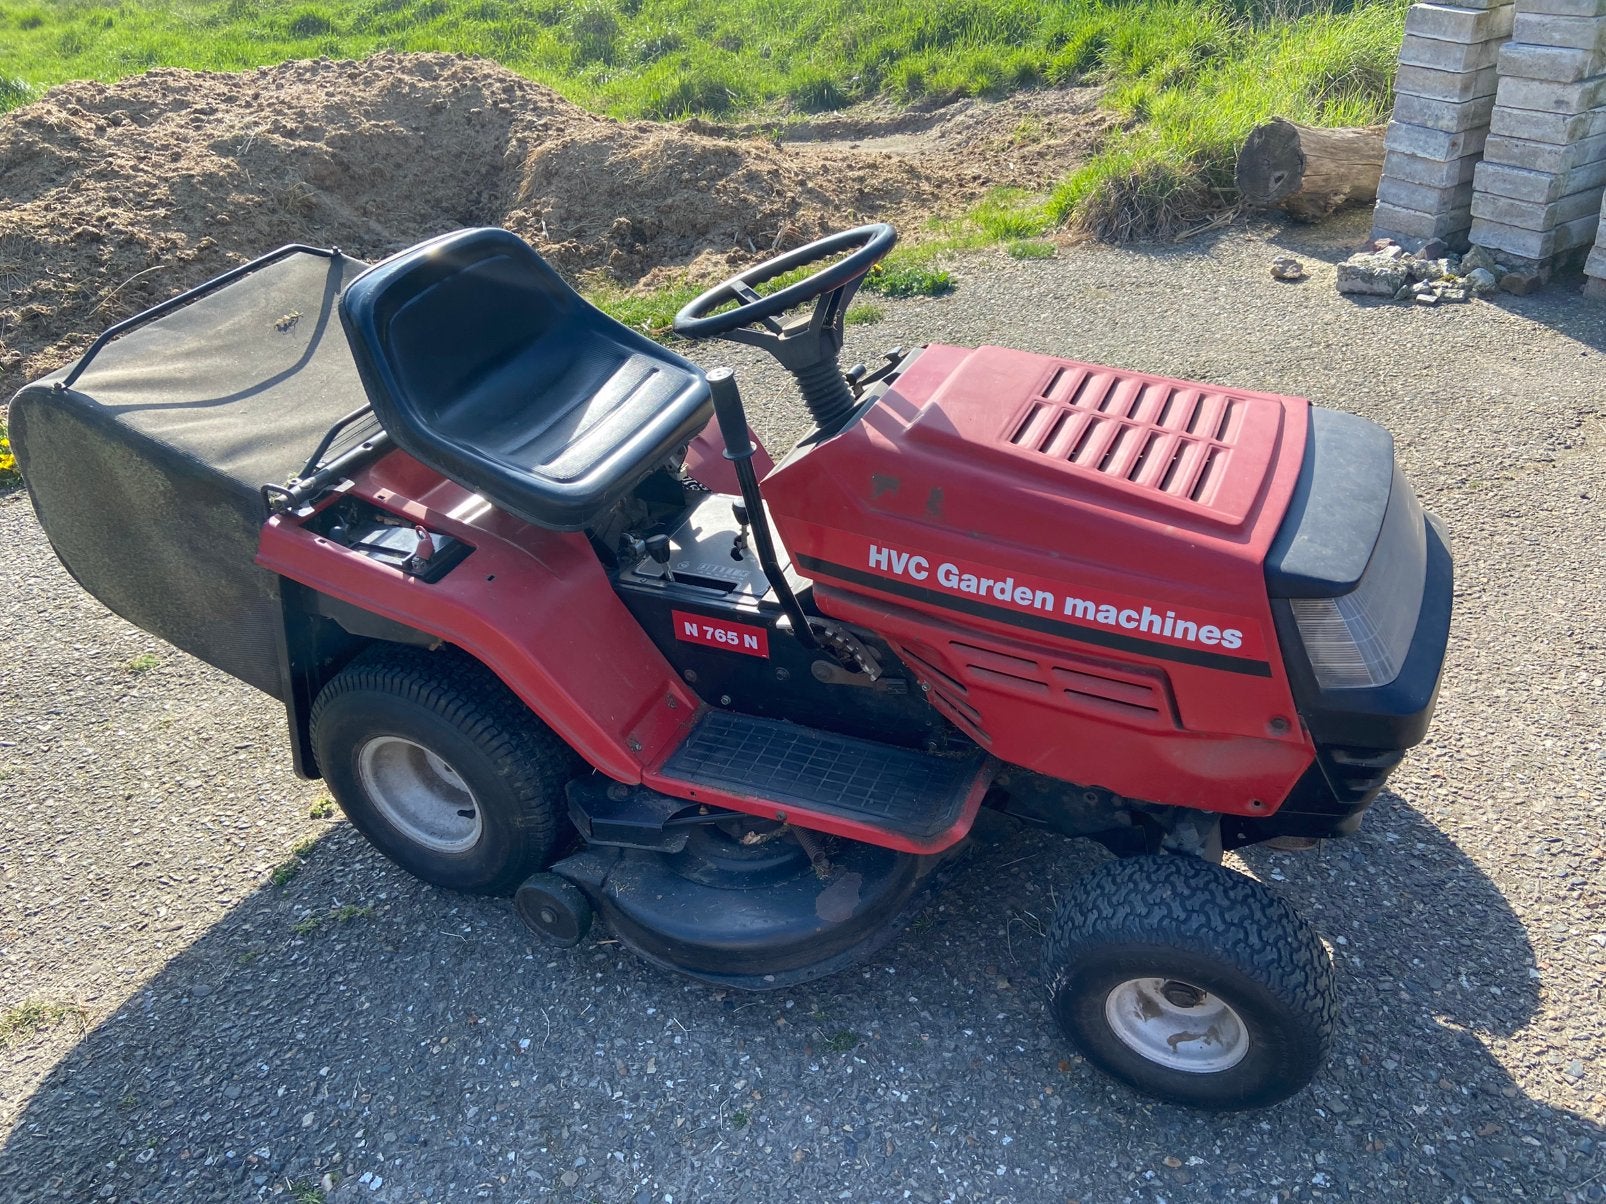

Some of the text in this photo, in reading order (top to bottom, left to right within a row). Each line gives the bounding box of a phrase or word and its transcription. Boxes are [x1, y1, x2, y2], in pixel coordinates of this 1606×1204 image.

[868, 544, 1243, 650] HVC Garden machines
[684, 621, 758, 650] N 765 N
